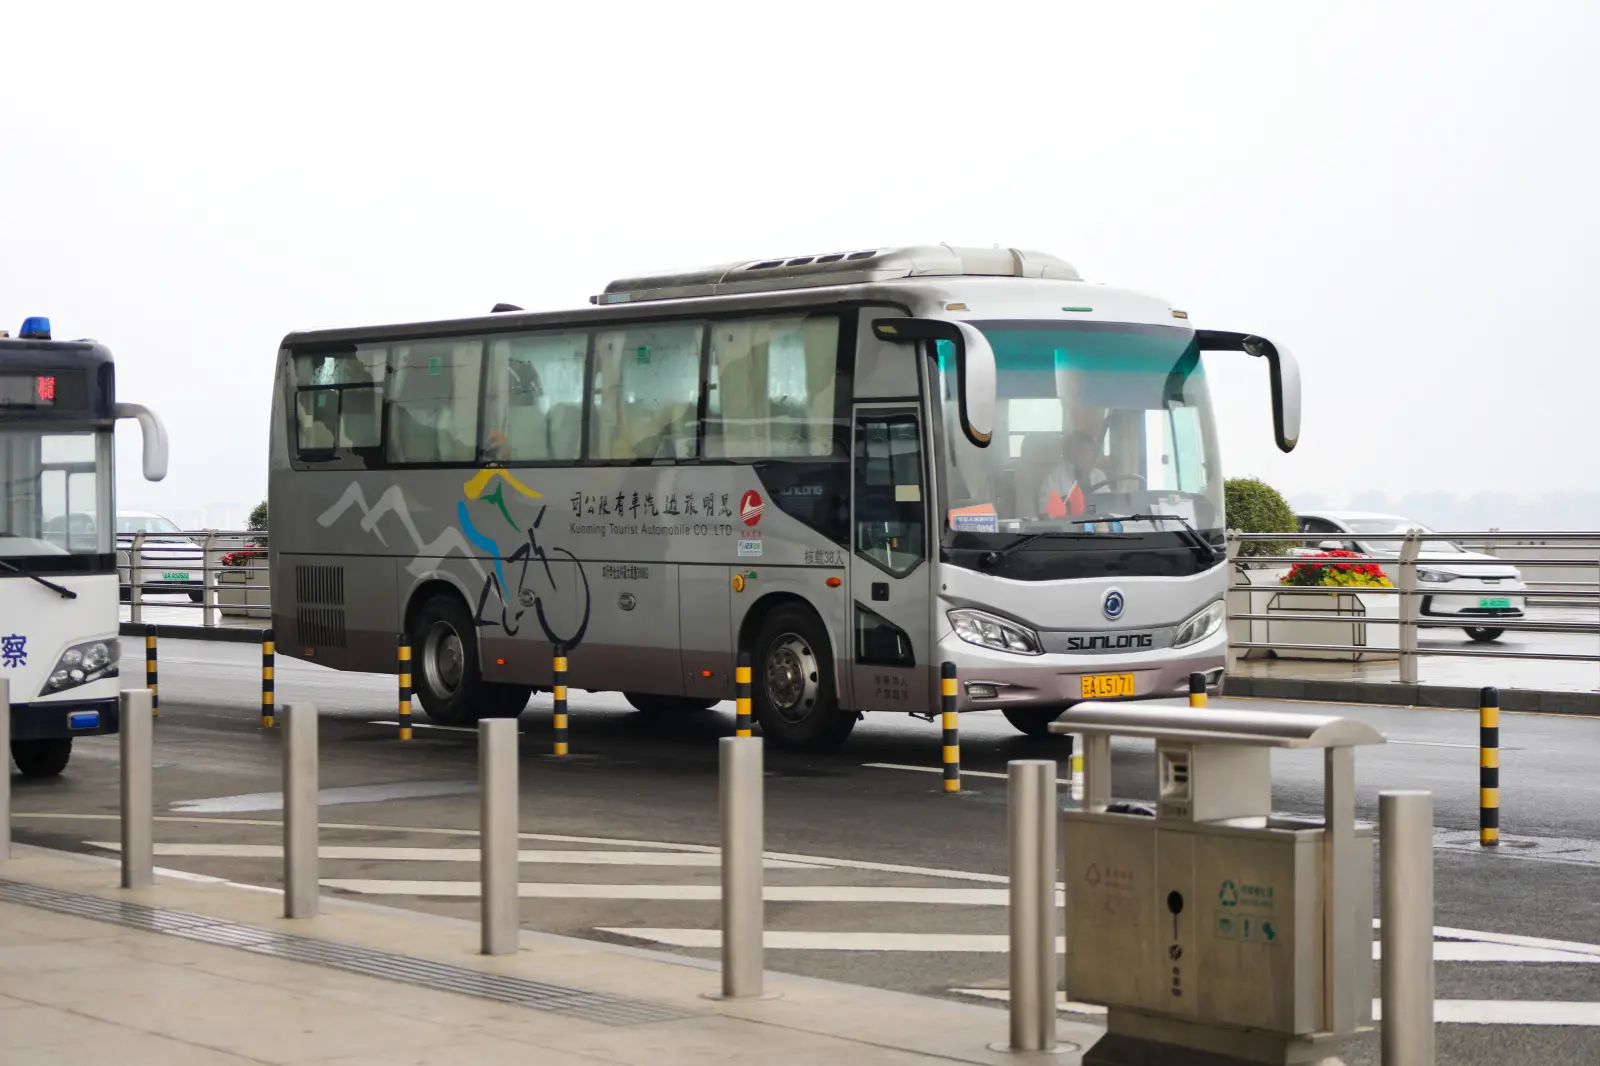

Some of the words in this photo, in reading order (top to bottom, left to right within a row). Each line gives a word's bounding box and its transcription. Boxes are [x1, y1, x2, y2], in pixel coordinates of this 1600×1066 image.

[570, 523, 606, 537] Kunming
[610, 524, 638, 536] Tourist
[641, 524, 690, 536] Automobile
[1067, 634, 1152, 650] SUNLONG
[1, 633, 28, 669] 察
